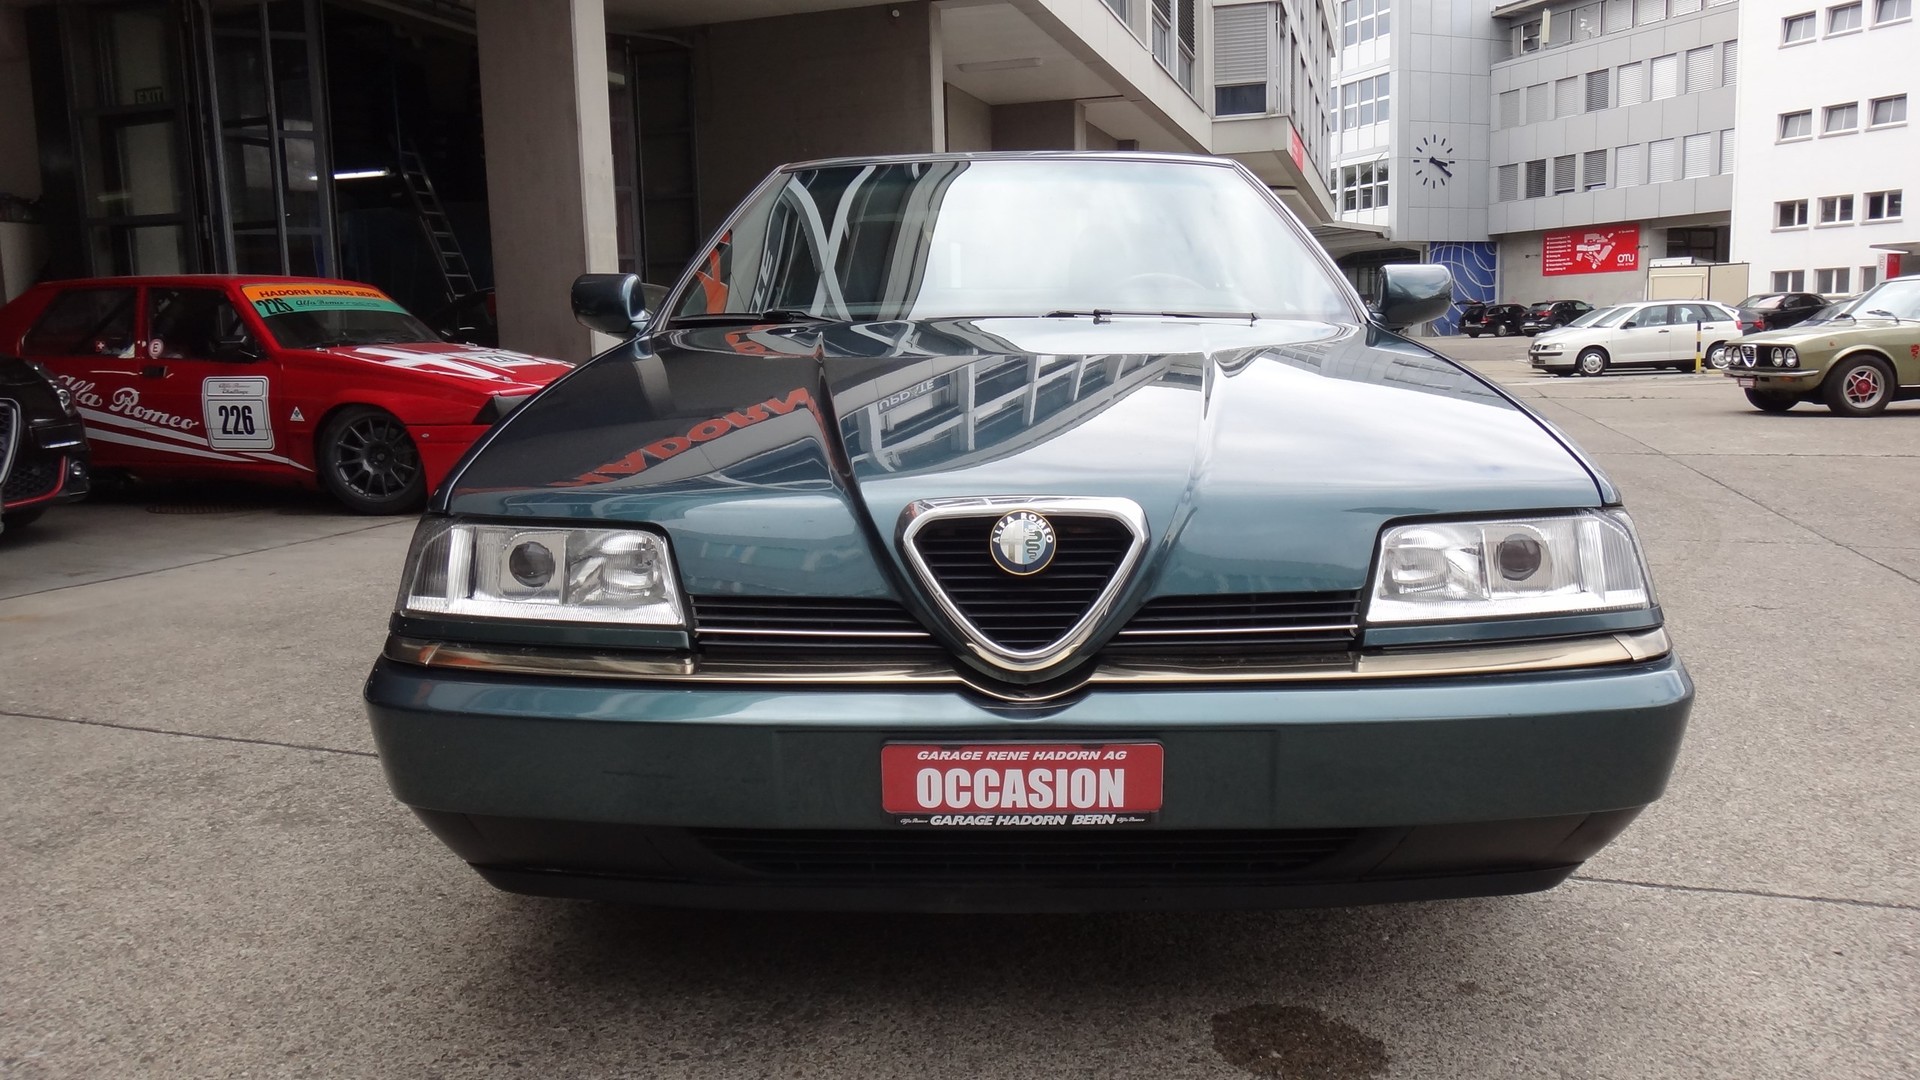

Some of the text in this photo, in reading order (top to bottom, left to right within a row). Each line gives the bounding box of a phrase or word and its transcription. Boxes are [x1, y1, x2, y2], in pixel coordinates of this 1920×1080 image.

[137, 90, 163, 104] EXIT
[259, 289, 311, 297] HADORN
[255, 298, 295, 315] 226
[109, 387, 199, 430] Romeo
[218, 405, 256, 435] 226
[992, 512, 1054, 544] ALFA ROMEO
[917, 750, 1128, 761] GARAGE RENE HADORN AG
[916, 768, 1125, 809] OCCASION
[930, 814, 1116, 826] GARAGE HADORN BERN
